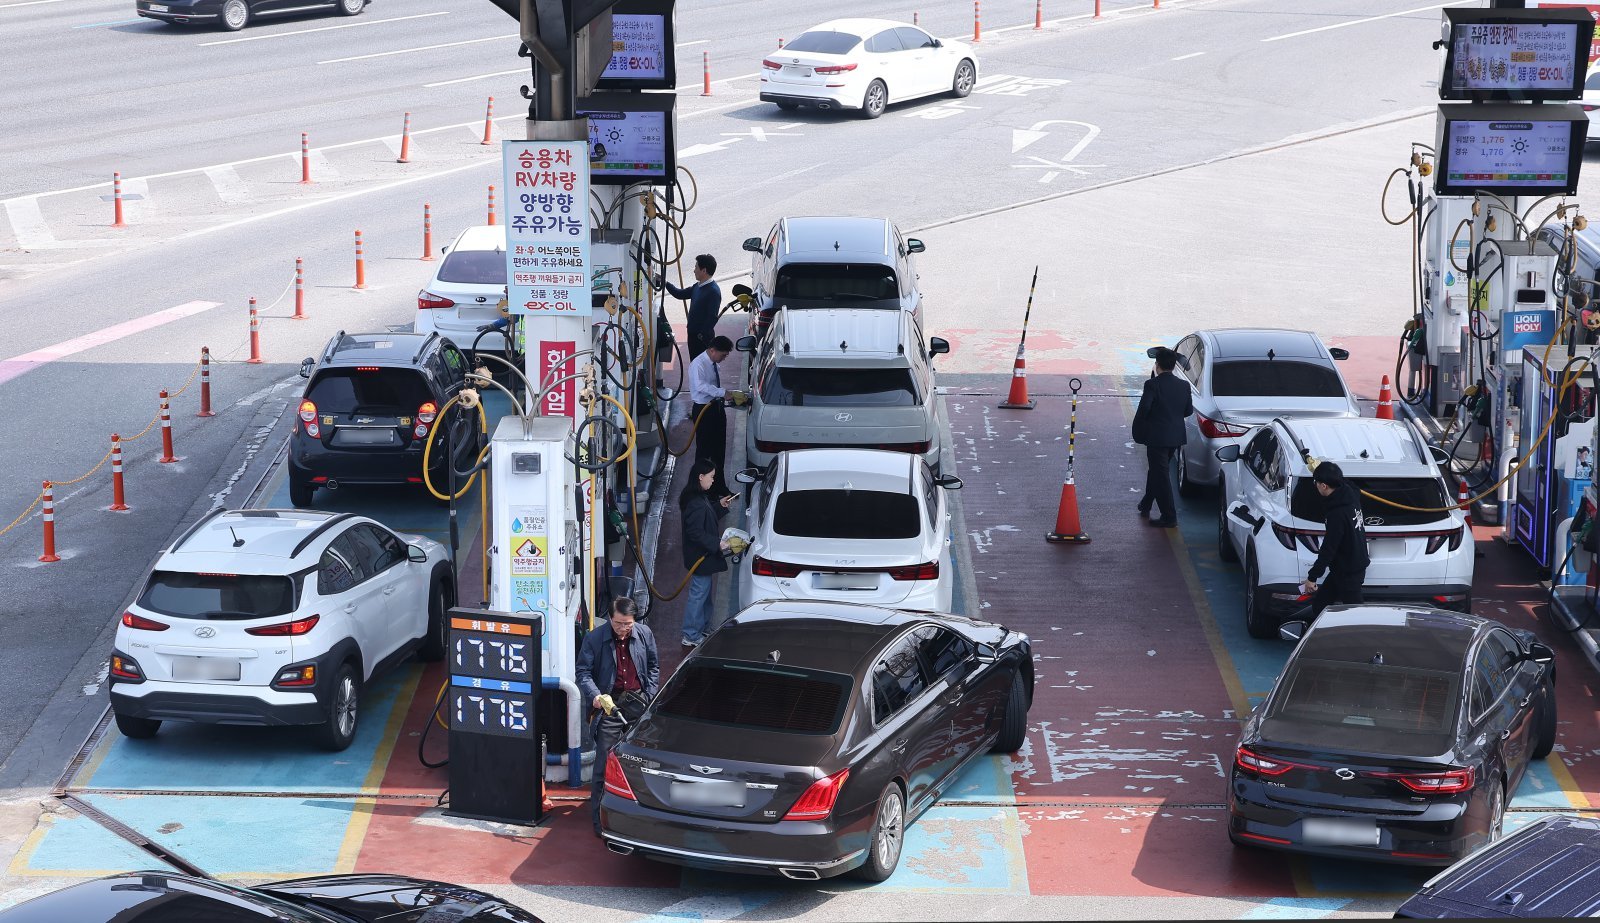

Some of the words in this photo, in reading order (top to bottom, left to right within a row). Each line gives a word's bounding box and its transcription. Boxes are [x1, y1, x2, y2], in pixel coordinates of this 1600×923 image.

[1471, 26, 1488, 45] 주유중
[1490, 26, 1500, 44] 엔진
[1481, 136, 1504, 144] 1,776
[518, 149, 572, 169] 승용차
[515, 171, 577, 191] RV차량
[520, 193, 574, 214] 양방향
[512, 215, 583, 235] 주유가능
[538, 246, 581, 257] 어느쪽이든
[513, 257, 539, 267] 편하게
[541, 258, 583, 268] 주유하세요
[515, 274, 537, 284] 역주행
[568, 275, 582, 284] 금지
[1515, 315, 1541, 324] LIQUI
[1515, 323, 1541, 332] MOLY
[456, 638, 527, 673] 1776
[456, 695, 528, 731] 1776
